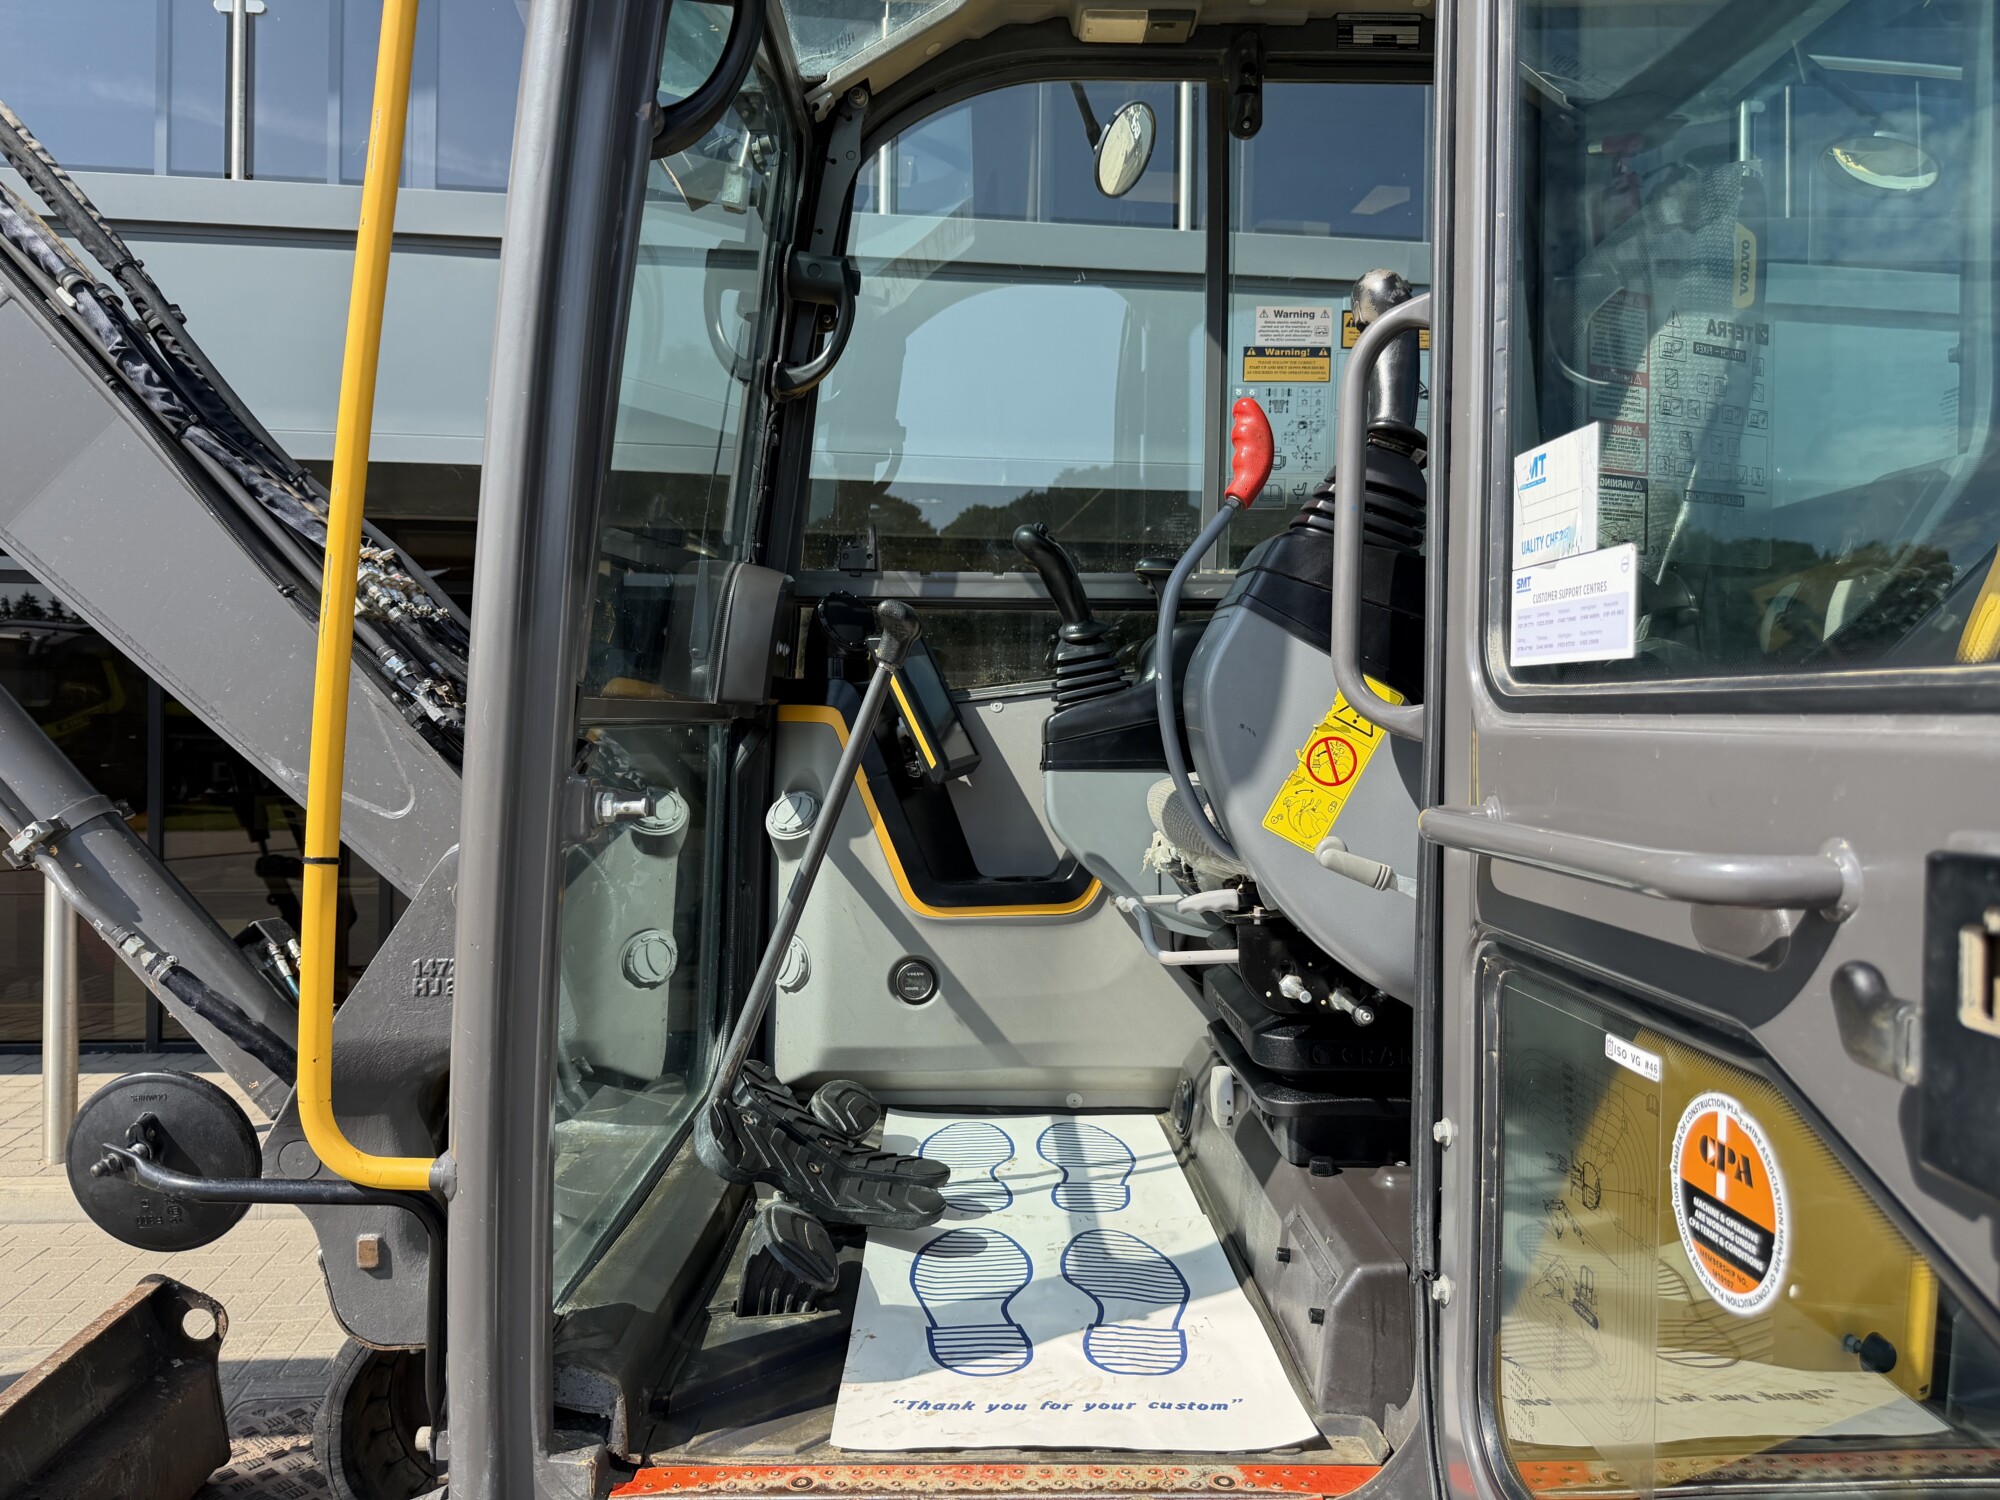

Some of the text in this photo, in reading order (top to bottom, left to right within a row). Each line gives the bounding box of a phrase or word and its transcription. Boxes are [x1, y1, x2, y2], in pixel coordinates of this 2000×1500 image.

[1740, 240, 1750, 296] VOLVO
[1273, 310, 1315, 320] Warning
[1265, 348, 1310, 357] Warning!
[1521, 535, 1544, 556] UALITY
[1516, 576, 1532, 590] SMT
[1532, 580, 1608, 604] CUSTOMER SUPPORT CENTRES
[1614, 1044, 1658, 1074] ISO VG #46
[1673, 1133, 1684, 1175] MEMBER
[1680, 1121, 1687, 1134] OF
[1686, 1098, 1726, 1124] CONSTRUCTION
[1760, 1147, 1784, 1224] ASSOCIATION
[1700, 1134, 1754, 1189] CPA
[1674, 1182, 1693, 1253] ASSOCIATION
[1693, 1196, 1759, 1244] MACHINE & OPERATIVE
[1694, 1209, 1757, 1255] ARE WORKING UNDER
[1689, 1217, 1764, 1272] CPA TERMS & CONDITIONS
[1699, 1248, 1735, 1278] MEMBERSHIP
[1726, 1286, 1770, 1309] CONSTRUCTION
[984, 1401, 1028, 1413] you
[1040, 1400, 1074, 1411] for
[1082, 1400, 1136, 1412] your
